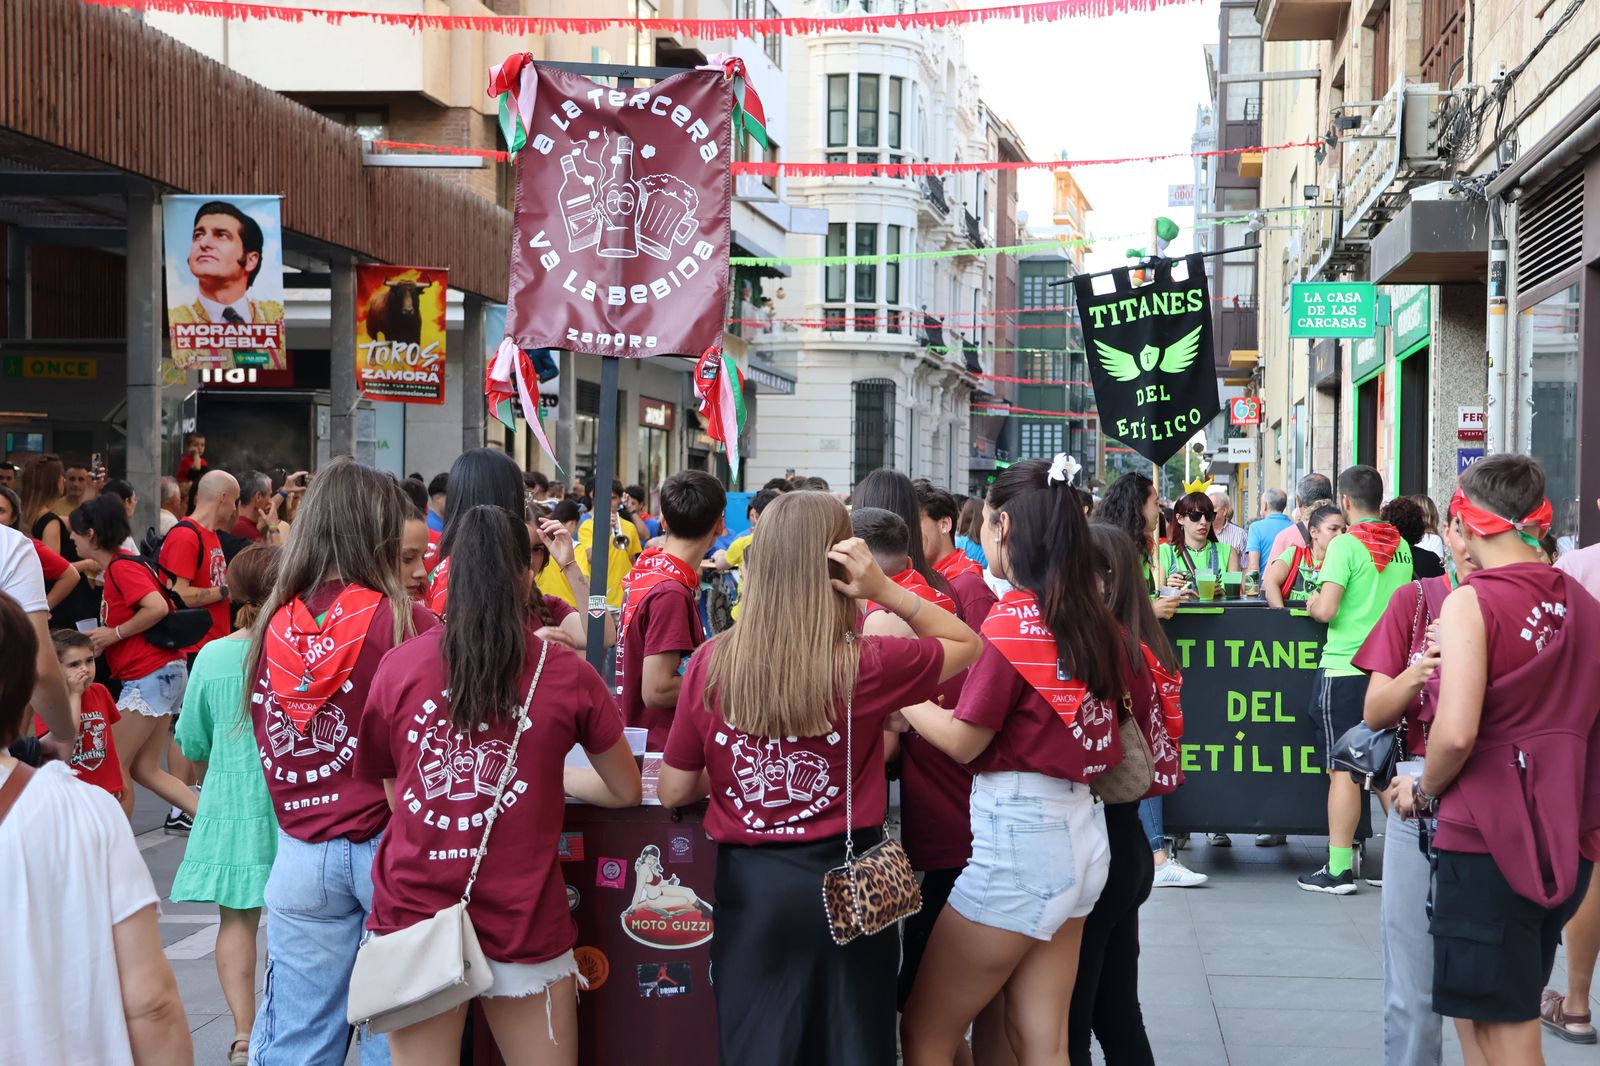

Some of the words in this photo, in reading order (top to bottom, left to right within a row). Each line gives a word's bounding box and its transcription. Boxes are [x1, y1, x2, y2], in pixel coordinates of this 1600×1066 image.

[1304, 293, 1322, 302] LA
[1327, 293, 1362, 302] CASA
[1089, 288, 1203, 329] TITANES
[1308, 306, 1325, 315] DE
[1332, 306, 1357, 315] LAS
[176, 325, 277, 336] MORANTE
[1297, 318, 1367, 328] CARCASAS
[195, 337, 276, 348] PUEBLA
[359, 340, 439, 368] TOROS
[31, 361, 89, 376] ONCE
[362, 368, 440, 383] ZAMORA
[1136, 385, 1170, 407] DEL
[1116, 408, 1201, 441] ETÍLICO
[1177, 640, 1318, 669] TITANE
[287, 701, 317, 711] ZAMORA
[1052, 695, 1078, 703] ZAMORA
[1227, 691, 1296, 723] DEL
[1180, 730, 1330, 773] ETÍLIC
[631, 919, 667, 931] MOTO
[672, 920, 710, 932] GUZZI
